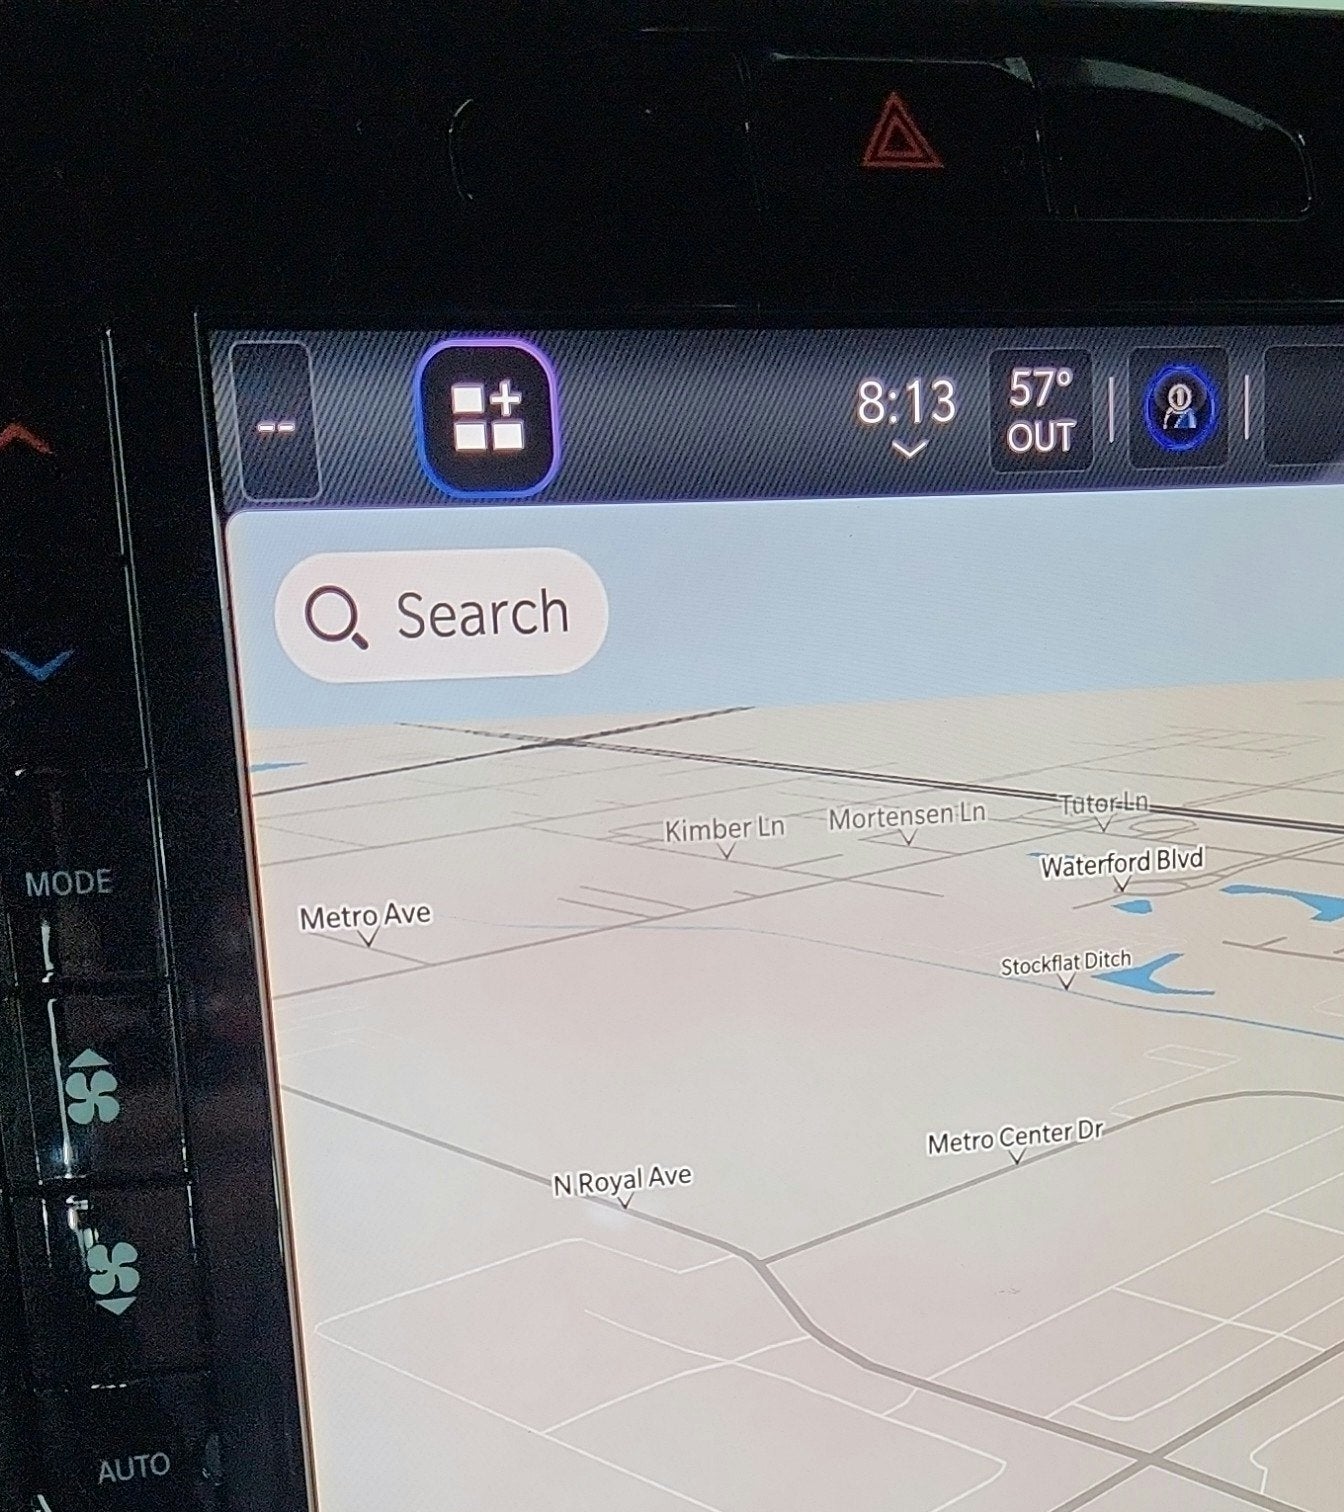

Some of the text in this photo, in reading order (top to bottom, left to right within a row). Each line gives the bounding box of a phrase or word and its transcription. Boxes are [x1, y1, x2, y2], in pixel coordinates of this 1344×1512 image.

[859, 380, 955, 423] 8:13
[1008, 421, 1075, 452] OUT
[397, 589, 568, 638] Search
[829, 802, 985, 830] Mortensen Ln
[1062, 792, 1148, 814] Tutor Ln
[665, 816, 784, 842] Kimber Ln
[1041, 847, 1203, 877] Waterford Blvd
[25, 869, 112, 897] MODE
[300, 904, 431, 930] Metro Ave
[1001, 949, 1131, 975] Stockflat Ditch
[927, 1119, 1103, 1154] Metro Center Dr
[554, 1165, 692, 1195] N Royal Ave
[98, 1452, 170, 1484] AUTO
